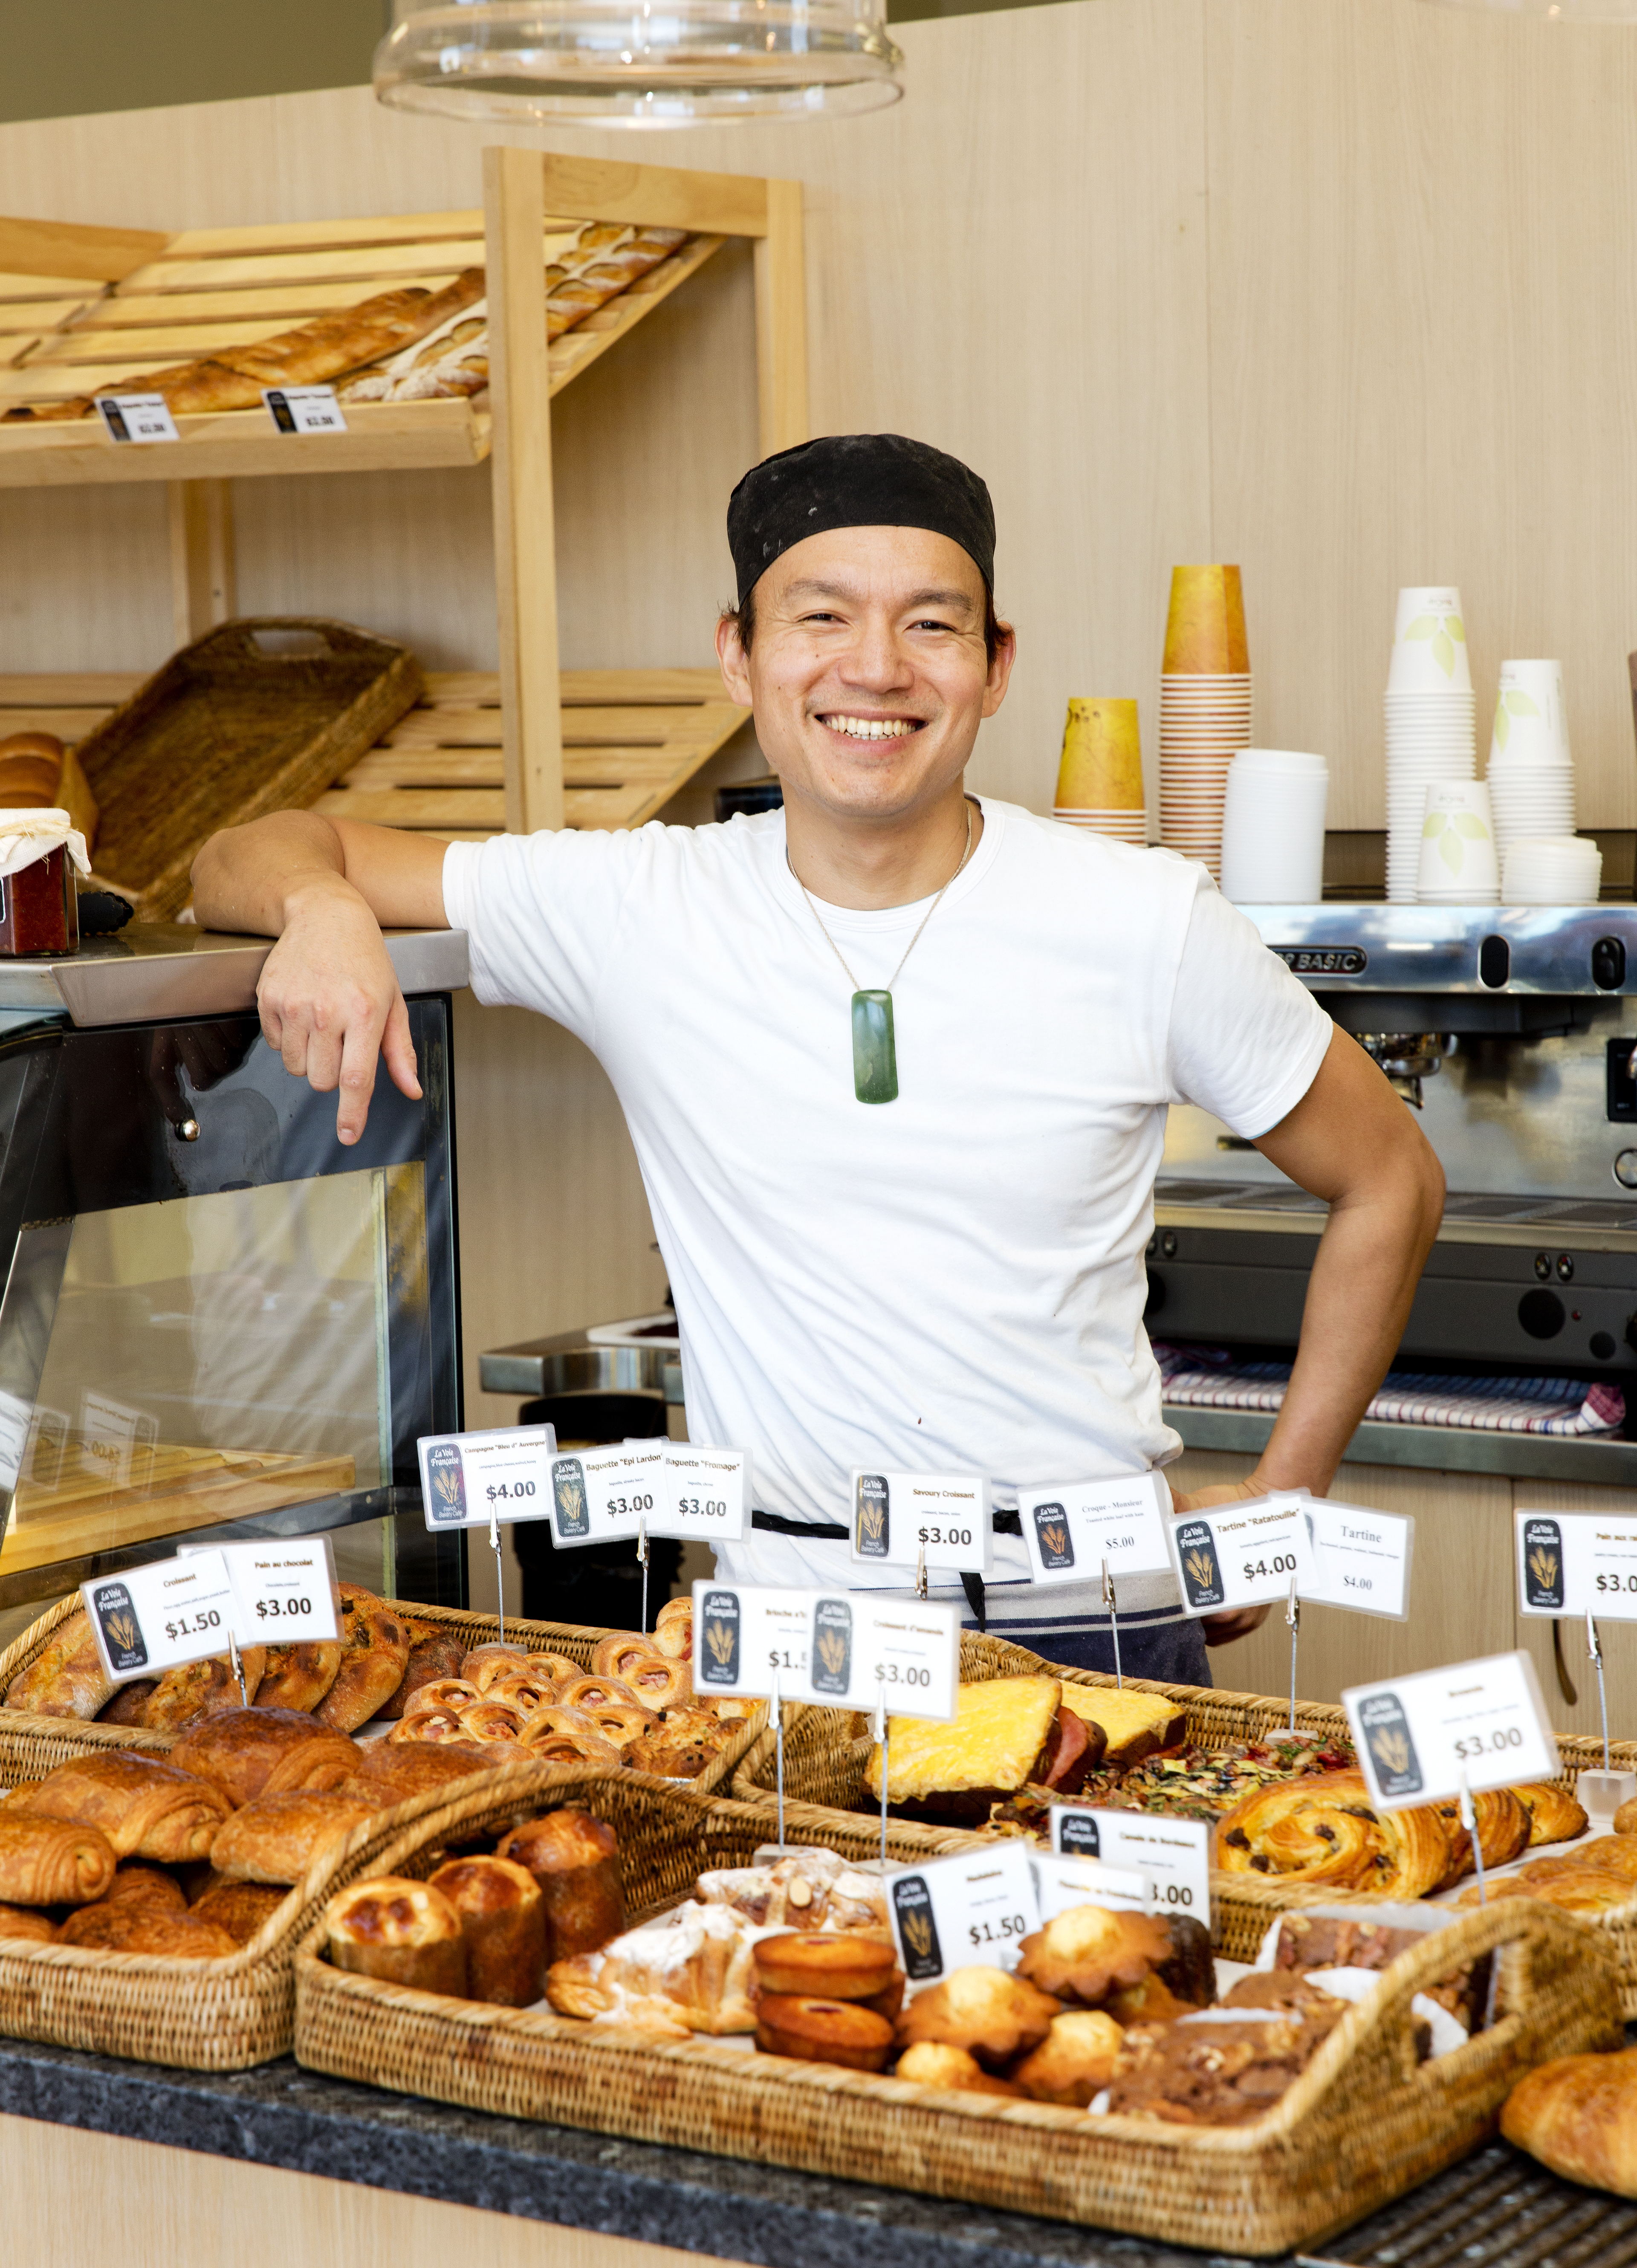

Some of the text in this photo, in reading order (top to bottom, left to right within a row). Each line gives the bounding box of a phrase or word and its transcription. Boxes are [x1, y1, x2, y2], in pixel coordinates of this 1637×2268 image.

[1297, 953, 1357, 970] BASIC
[434, 1449, 442, 1458] La
[431, 1457, 459, 1467] Française
[558, 1464, 576, 1473] La Voie
[586, 1461, 618, 1471] Baguette
[665, 1458, 699, 1467] Baguette
[555, 1471, 581, 1482] Française
[486, 1481, 535, 1503] $4.00
[863, 1480, 882, 1489] La Voie
[913, 1489, 975, 1499] Savoury Croissant
[607, 1494, 653, 1518] $3.00
[679, 1497, 726, 1516] $3.00
[1112, 1500, 1143, 1509] Monsieur
[1183, 1529, 1192, 1538] La
[1216, 1521, 1246, 1533] Tartine
[1341, 1525, 1382, 1543] Tartine
[918, 1526, 972, 1546] $3.00
[1106, 1536, 1134, 1550] $5.00
[1244, 1554, 1296, 1582] $4.00
[164, 1574, 197, 1587] Croissant
[1343, 1575, 1372, 1590] $4.00
[256, 1598, 311, 1621] $3.00
[165, 1610, 220, 1641] $1.50
[874, 1662, 930, 1687] $3.00
[1455, 1727, 1522, 1761] $3.00
[1152, 1882, 1192, 1906] 3.00
[970, 1914, 1025, 1949] $1.50
